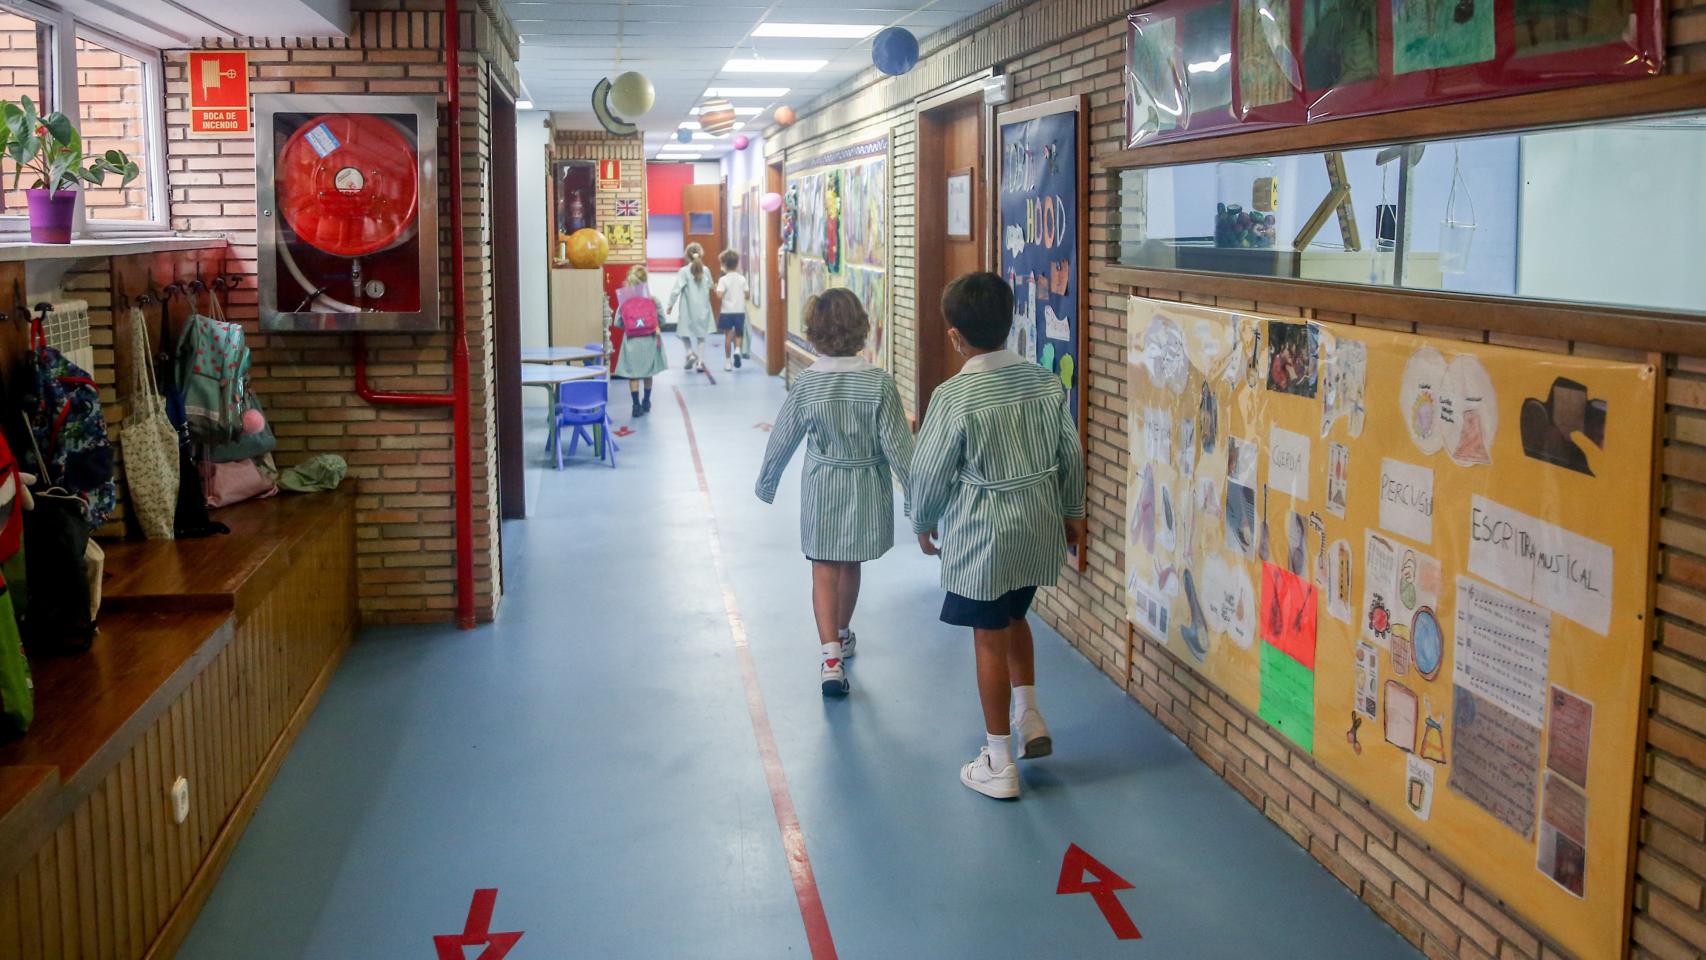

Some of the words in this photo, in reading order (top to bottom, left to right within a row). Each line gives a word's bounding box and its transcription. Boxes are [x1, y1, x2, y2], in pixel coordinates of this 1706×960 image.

[202, 121, 238, 129] INCENDIO
[203, 112, 224, 120] BOCA
[226, 112, 237, 120] DE
[1026, 195, 1066, 249] HOOD
[1537, 551, 1599, 592] MUSICAL
